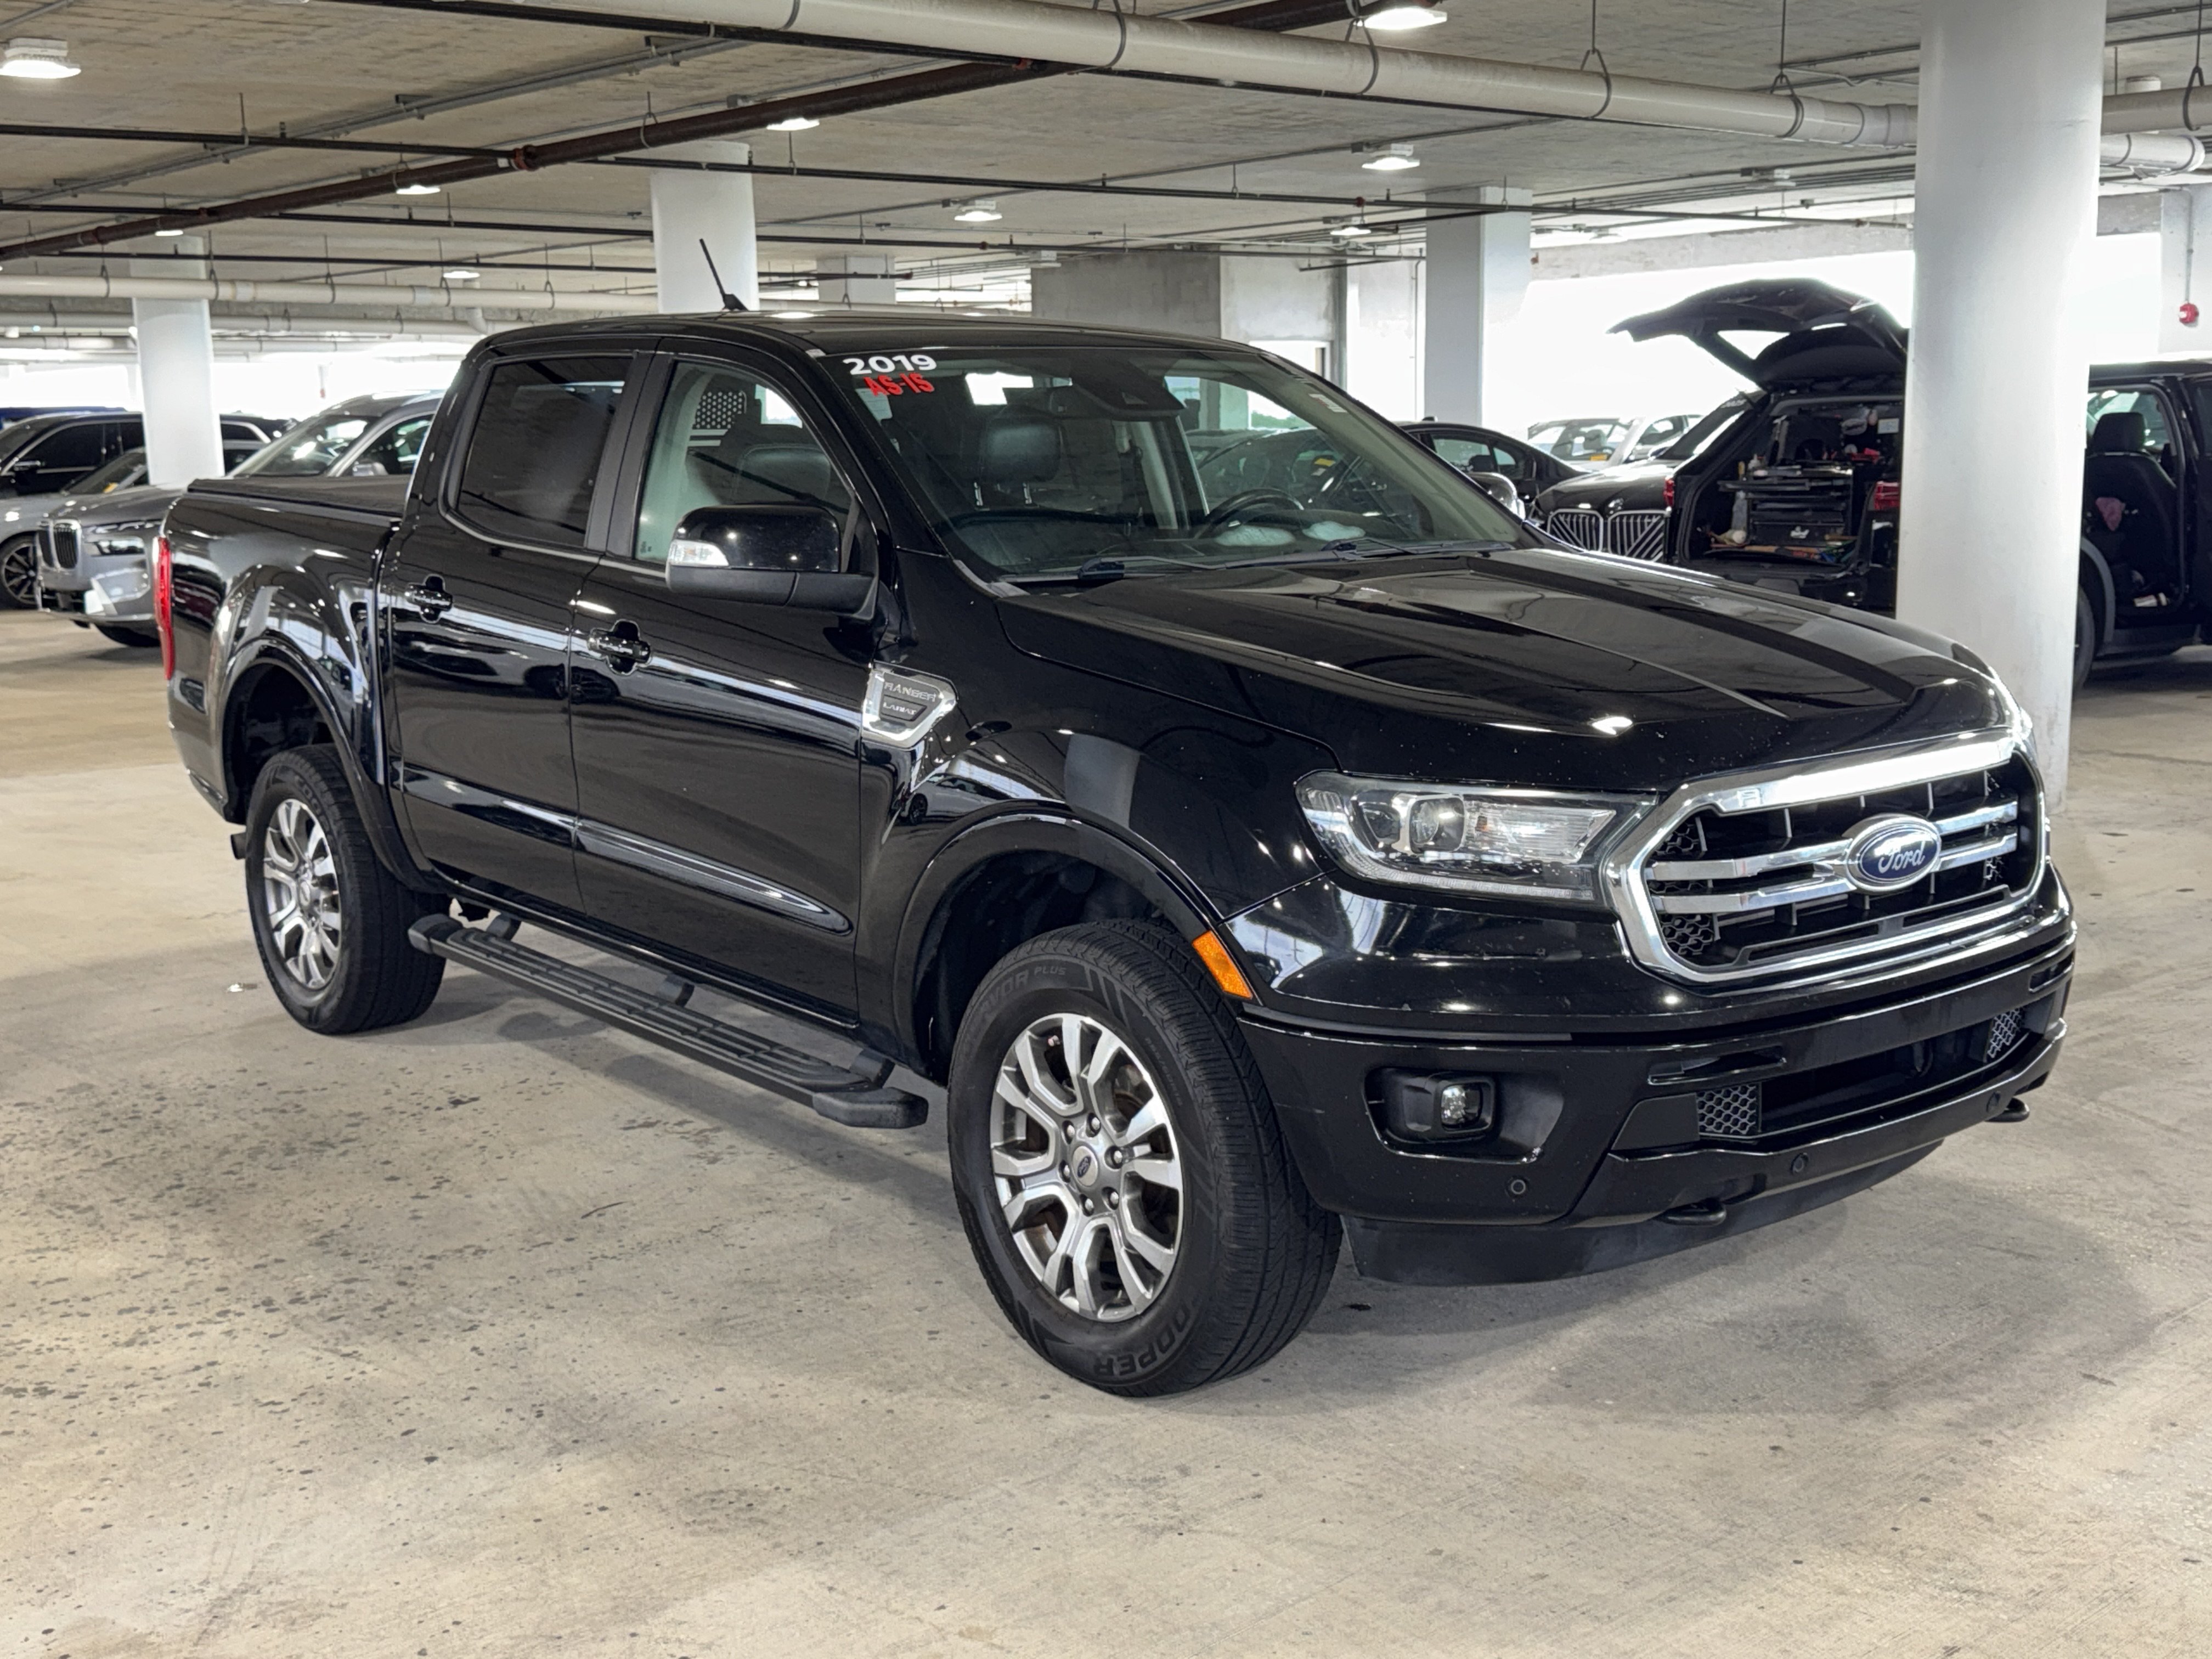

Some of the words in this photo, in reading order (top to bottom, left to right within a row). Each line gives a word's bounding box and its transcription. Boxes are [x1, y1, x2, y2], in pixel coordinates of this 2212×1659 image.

[843, 354, 937, 375] 2019
[864, 372, 934, 397] AS-IS
[884, 681, 936, 702] RANGER
[1877, 840, 1925, 874] Ford
[1034, 965, 1067, 976] PLUS
[1093, 1297, 1195, 1376] OOPER
